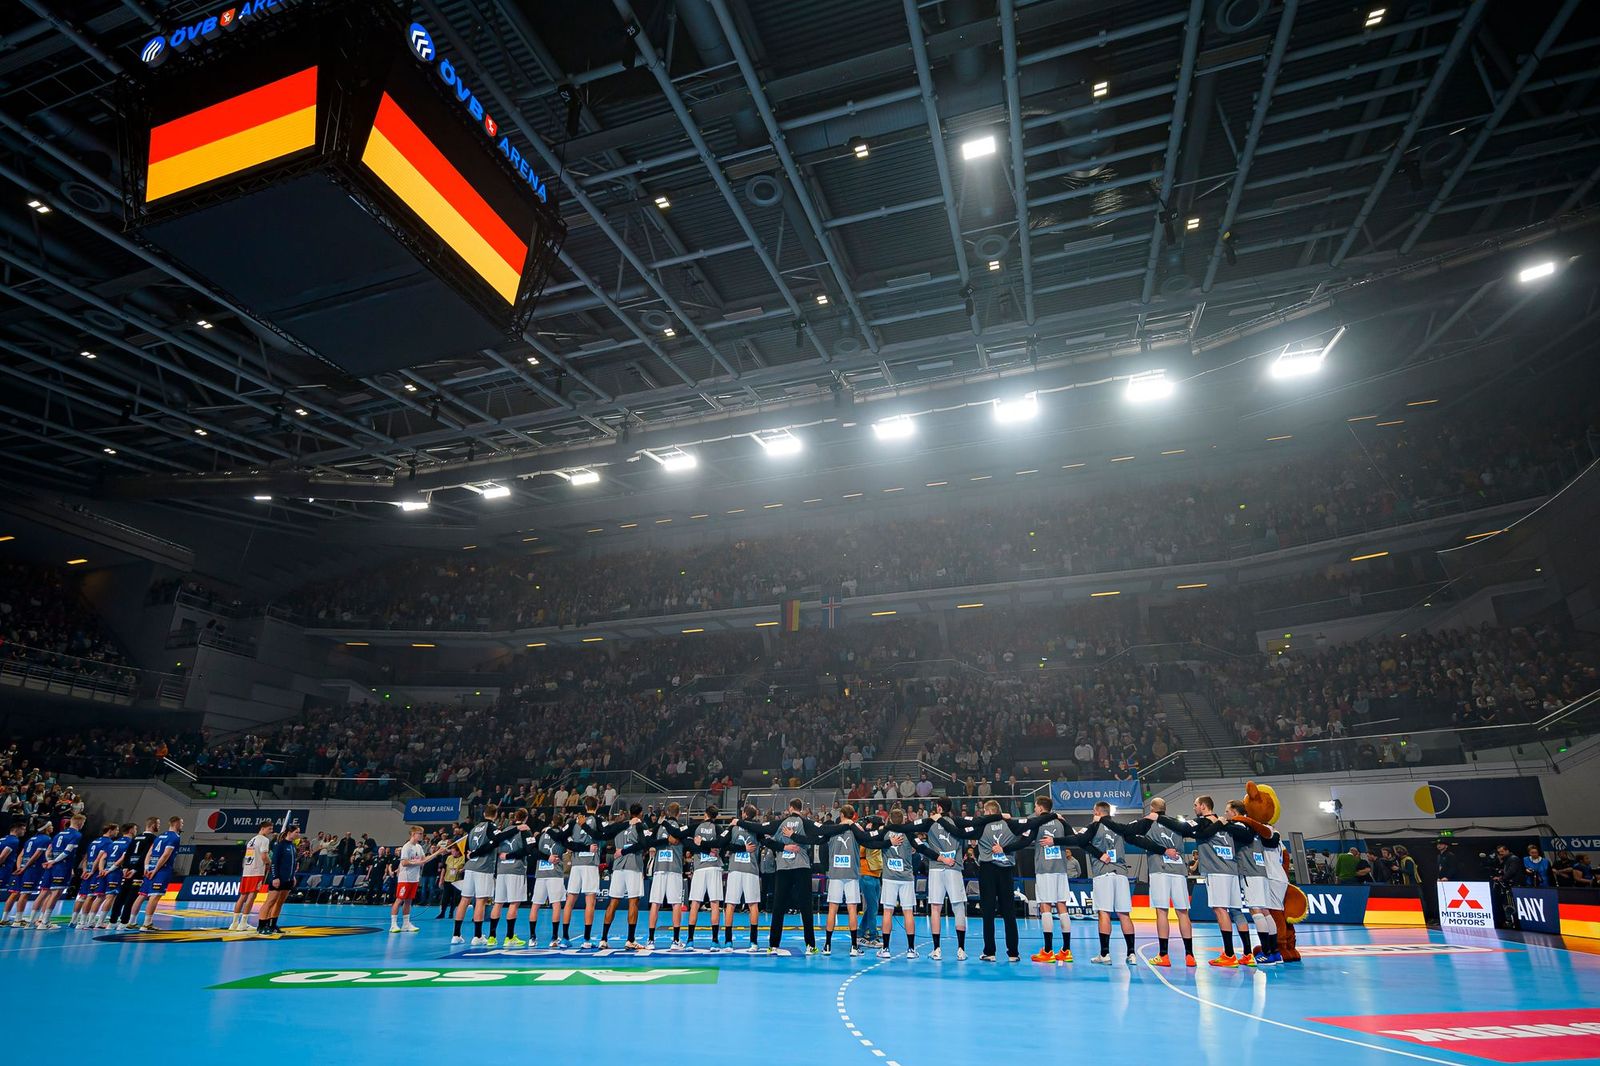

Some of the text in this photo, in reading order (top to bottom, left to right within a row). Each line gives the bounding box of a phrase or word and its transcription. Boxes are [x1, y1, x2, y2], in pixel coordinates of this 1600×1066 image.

[170, 16, 218, 47] ÖVB
[440, 58, 547, 204] ÖVB ARENA
[1103, 790, 1132, 798] ARENA
[233, 817, 253, 825] WIR.
[110, 845, 119, 857] 2
[134, 841, 140, 854] 1
[155, 839, 163, 853] 4
[888, 858, 902, 867] DKB
[191, 881, 241, 896] GERMAN
[1307, 893, 1343, 915] NY
[1441, 911, 1492, 919] MITSUBISHI
[1448, 918, 1486, 926] MOTORS
[268, 967, 706, 984] ALSCO
